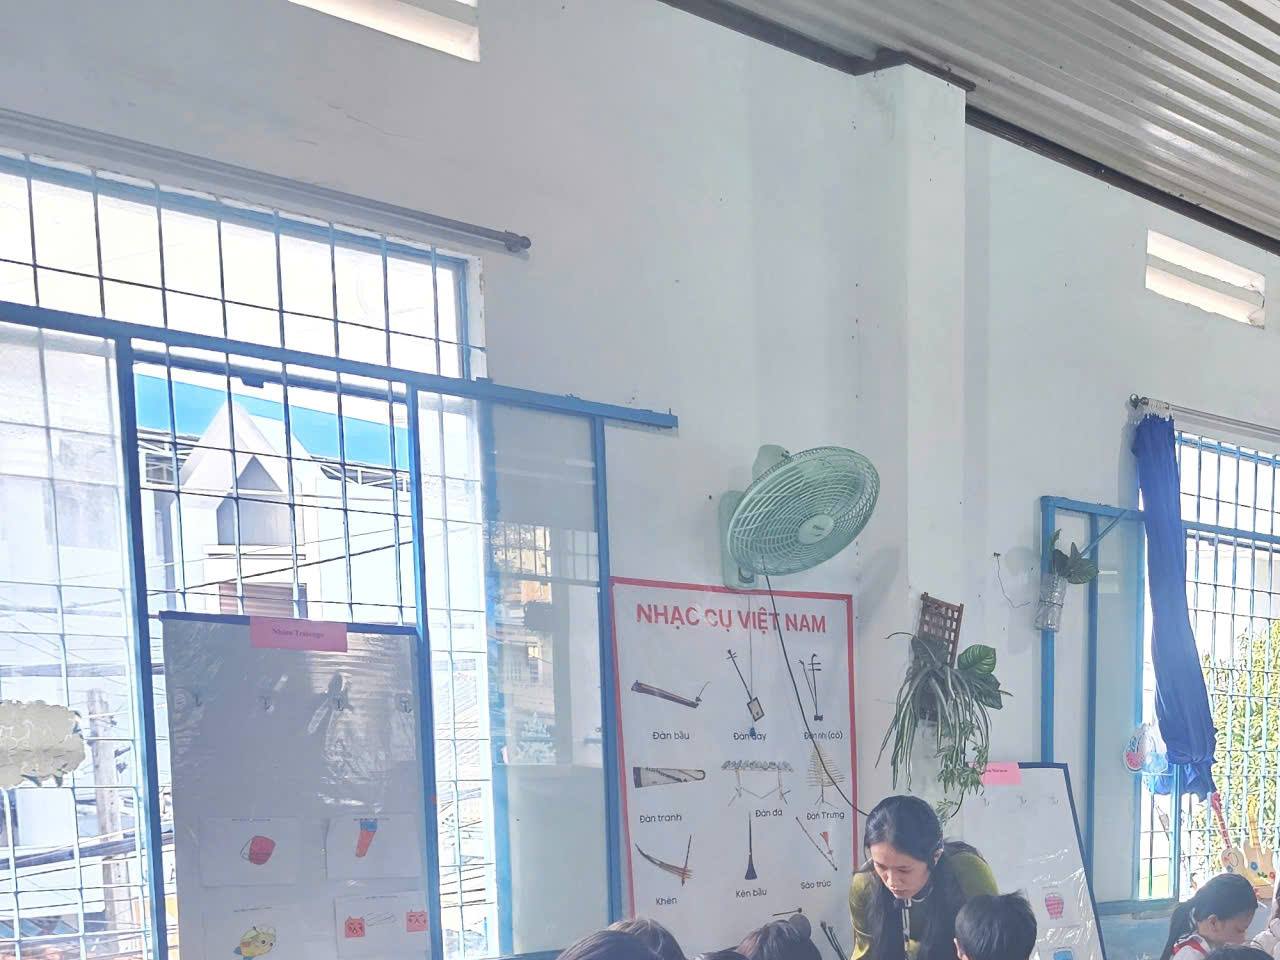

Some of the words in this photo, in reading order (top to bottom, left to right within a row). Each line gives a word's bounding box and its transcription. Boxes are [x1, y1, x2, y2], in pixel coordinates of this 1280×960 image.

[636, 604, 700, 630] NHẠC
[704, 608, 732, 632] CỤ
[737, 606, 780, 635] VIỆT
[784, 613, 826, 633] NAM
[652, 730, 672, 740] Đàn
